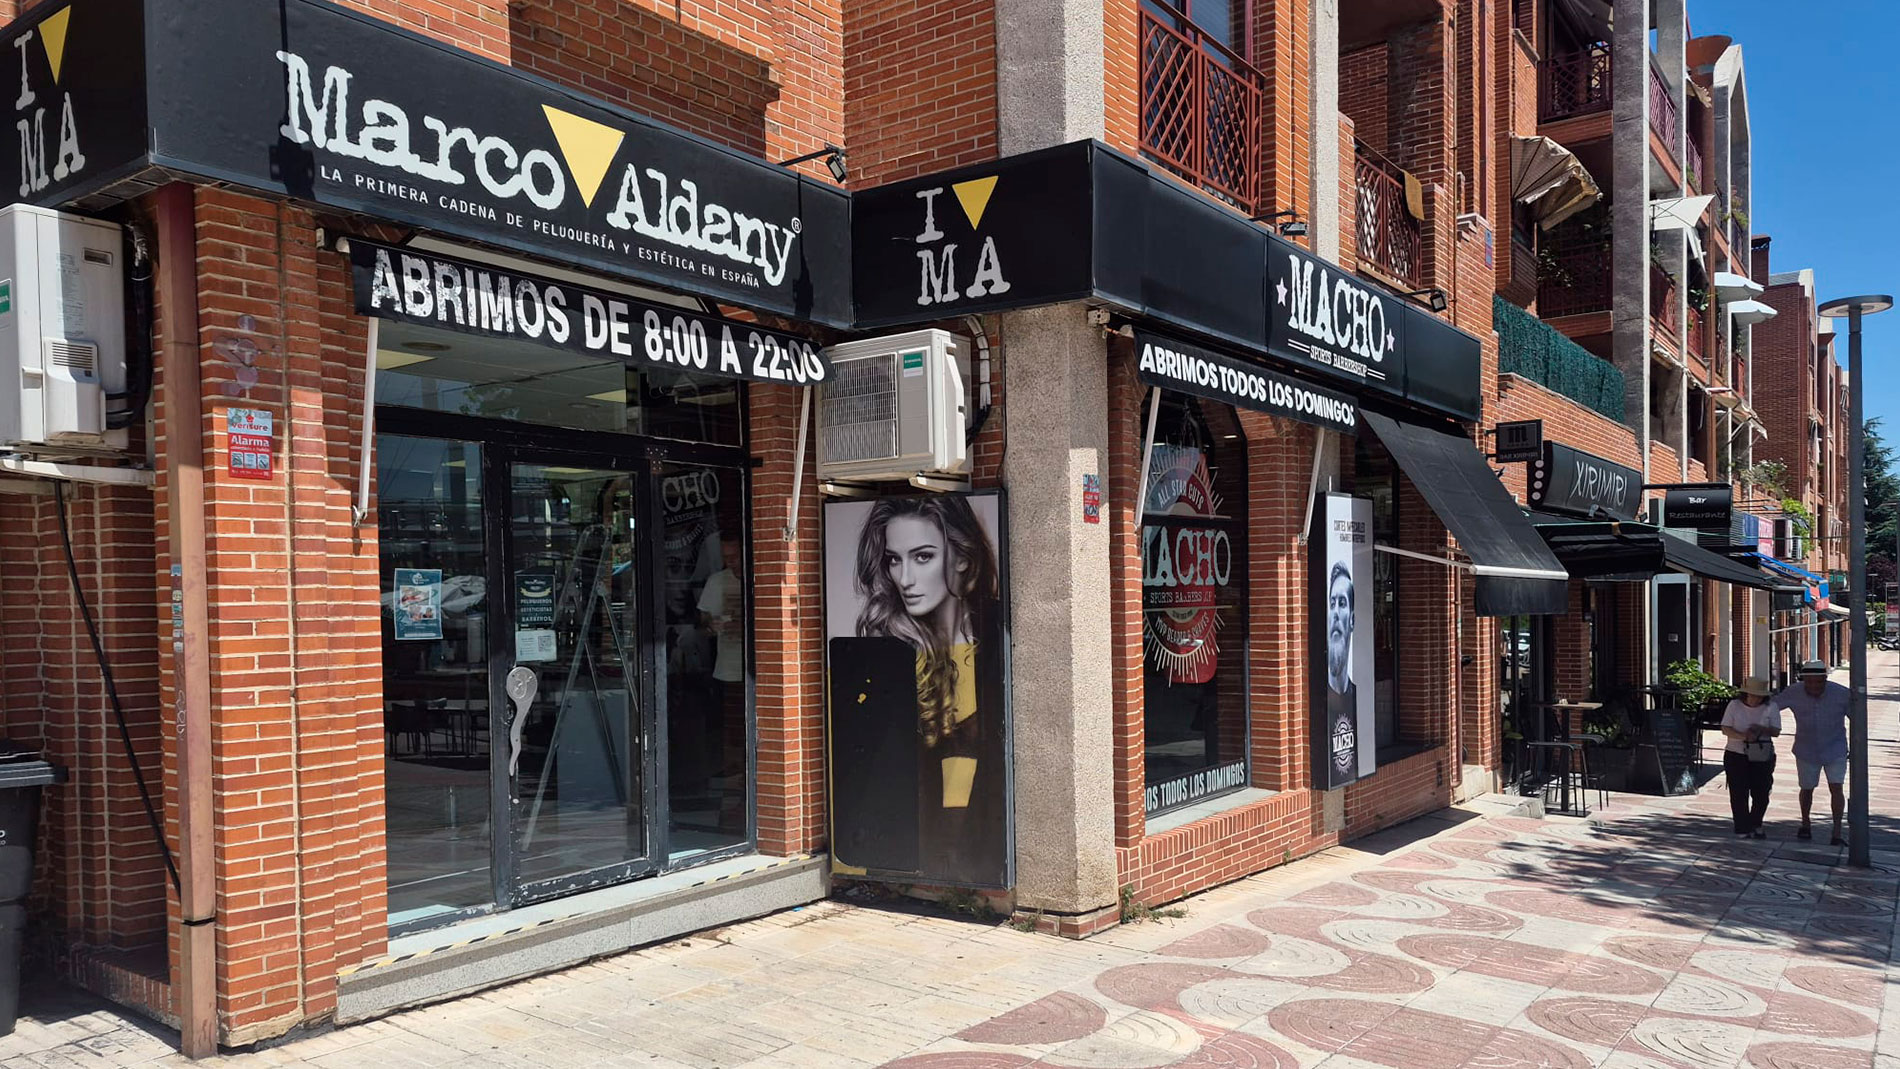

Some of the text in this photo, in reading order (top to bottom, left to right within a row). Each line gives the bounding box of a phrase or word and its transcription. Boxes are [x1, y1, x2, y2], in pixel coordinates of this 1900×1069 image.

[14, 30, 36, 111] I
[276, 50, 566, 210] Marco
[321, 165, 760, 288] LA PRIMERA CADENA DE PELUQUERÍA Y ESTÉTICA EN ESPAÑA
[915, 187, 944, 243] I
[370, 248, 825, 384] ABRIMOS DE 8:00 A 22:00
[1288, 254, 1385, 363] MACHO
[1140, 343, 1355, 427] ABRIMOS TODOS LOS DOMINGOS
[1310, 345, 1367, 378] SPORTS BARBERSHOP
[231, 435, 270, 447] Alarma
[1158, 479, 1205, 510] ALL STAR CUTS
[1569, 461, 1628, 509] XIRIMIRI
[1688, 496, 1708, 505] Bar
[1669, 512, 1726, 520] Restaurante
[1150, 591, 1173, 604] SPORTS
[1160, 777, 1187, 807] TODOS
[1189, 773, 1205, 798] LOS
[1206, 762, 1245, 793] DOMINGOS
